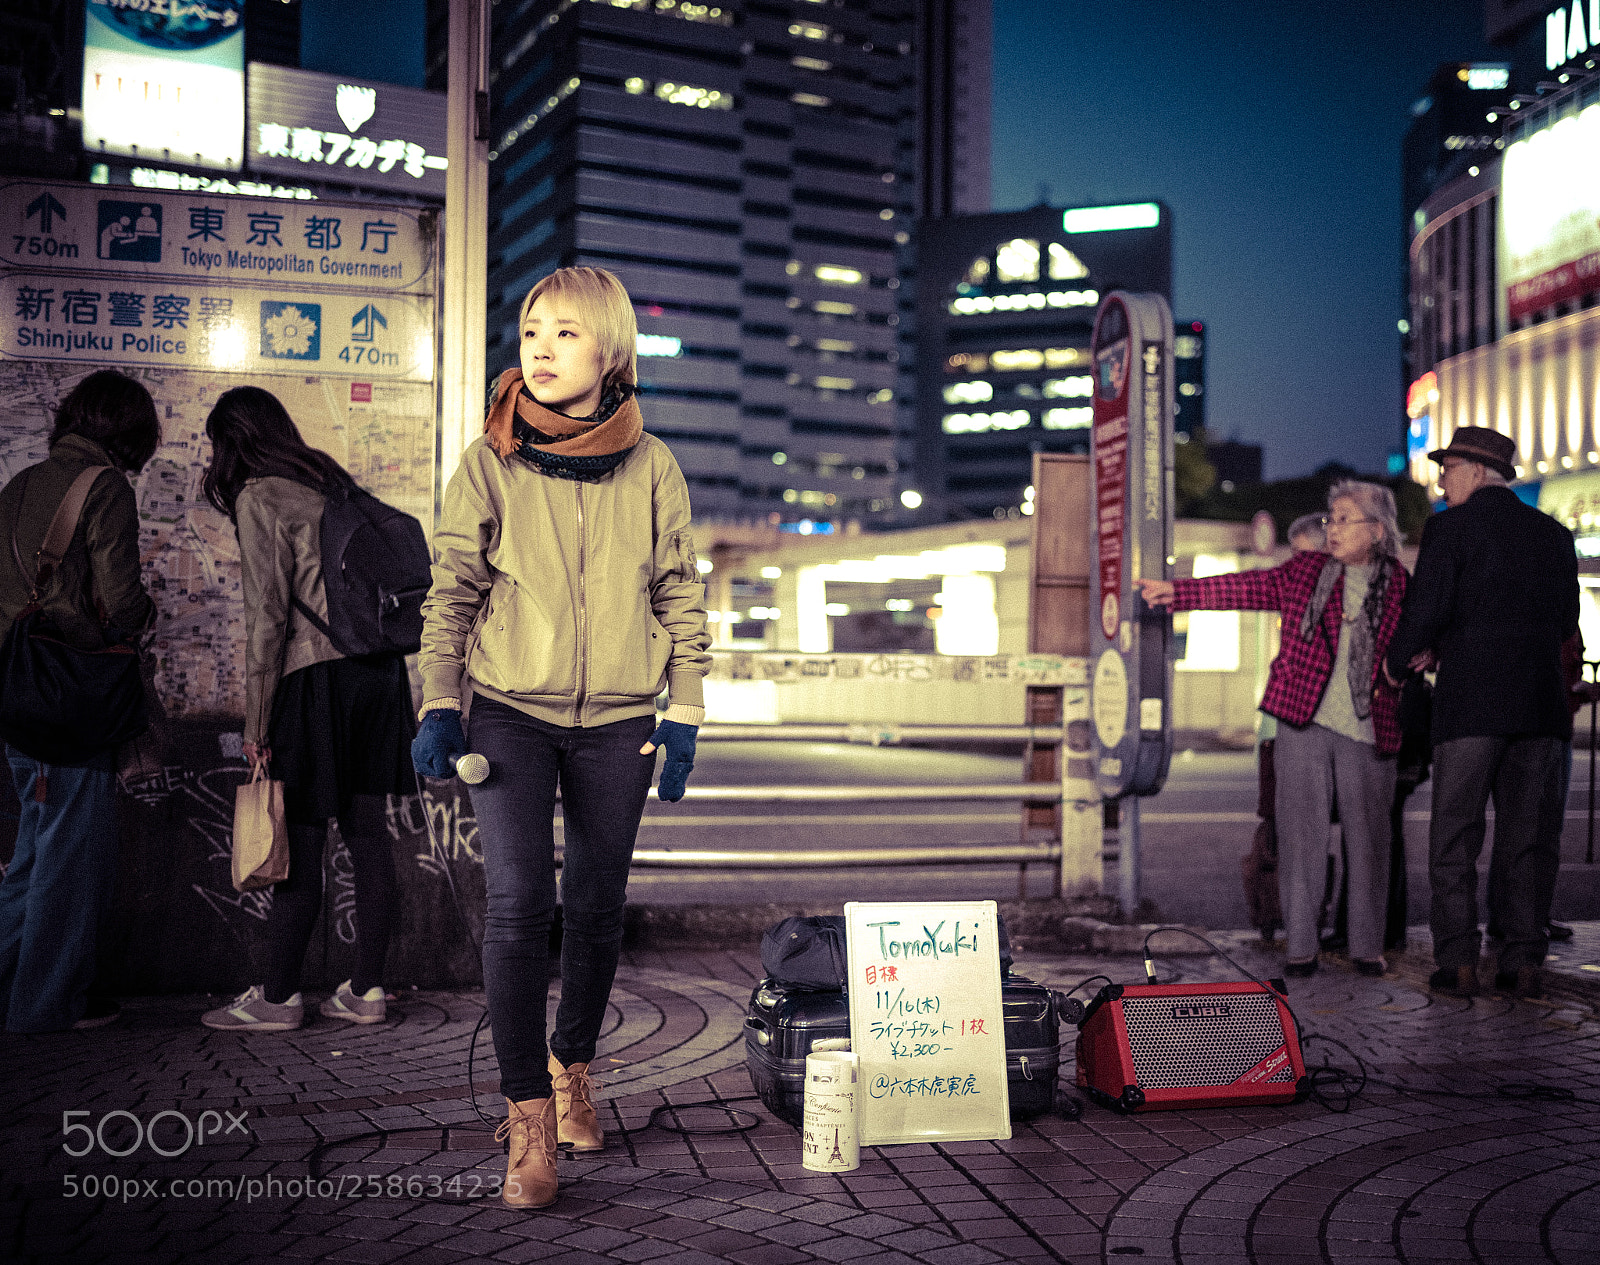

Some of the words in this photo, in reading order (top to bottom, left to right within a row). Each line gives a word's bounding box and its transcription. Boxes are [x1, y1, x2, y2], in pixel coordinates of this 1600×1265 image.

[257, 122, 449, 178] 東京アカデミー
[187, 206, 398, 254] 東京都庁
[13, 235, 79, 258] 750m
[181, 246, 222, 271] Tokyo
[227, 250, 314, 275] Metropolitan
[320, 256, 403, 279] Government
[17, 326, 113, 352] Shinjuku
[122, 333, 187, 354] Police
[338, 346, 399, 366] 470m
[866, 965, 899, 985] 目標
[1175, 1005, 1229, 1018] CUBE
[870, 1020, 954, 1040] ライブチケット
[961, 1019, 989, 1036] 1枚
[804, 1130, 814, 1142] ON
